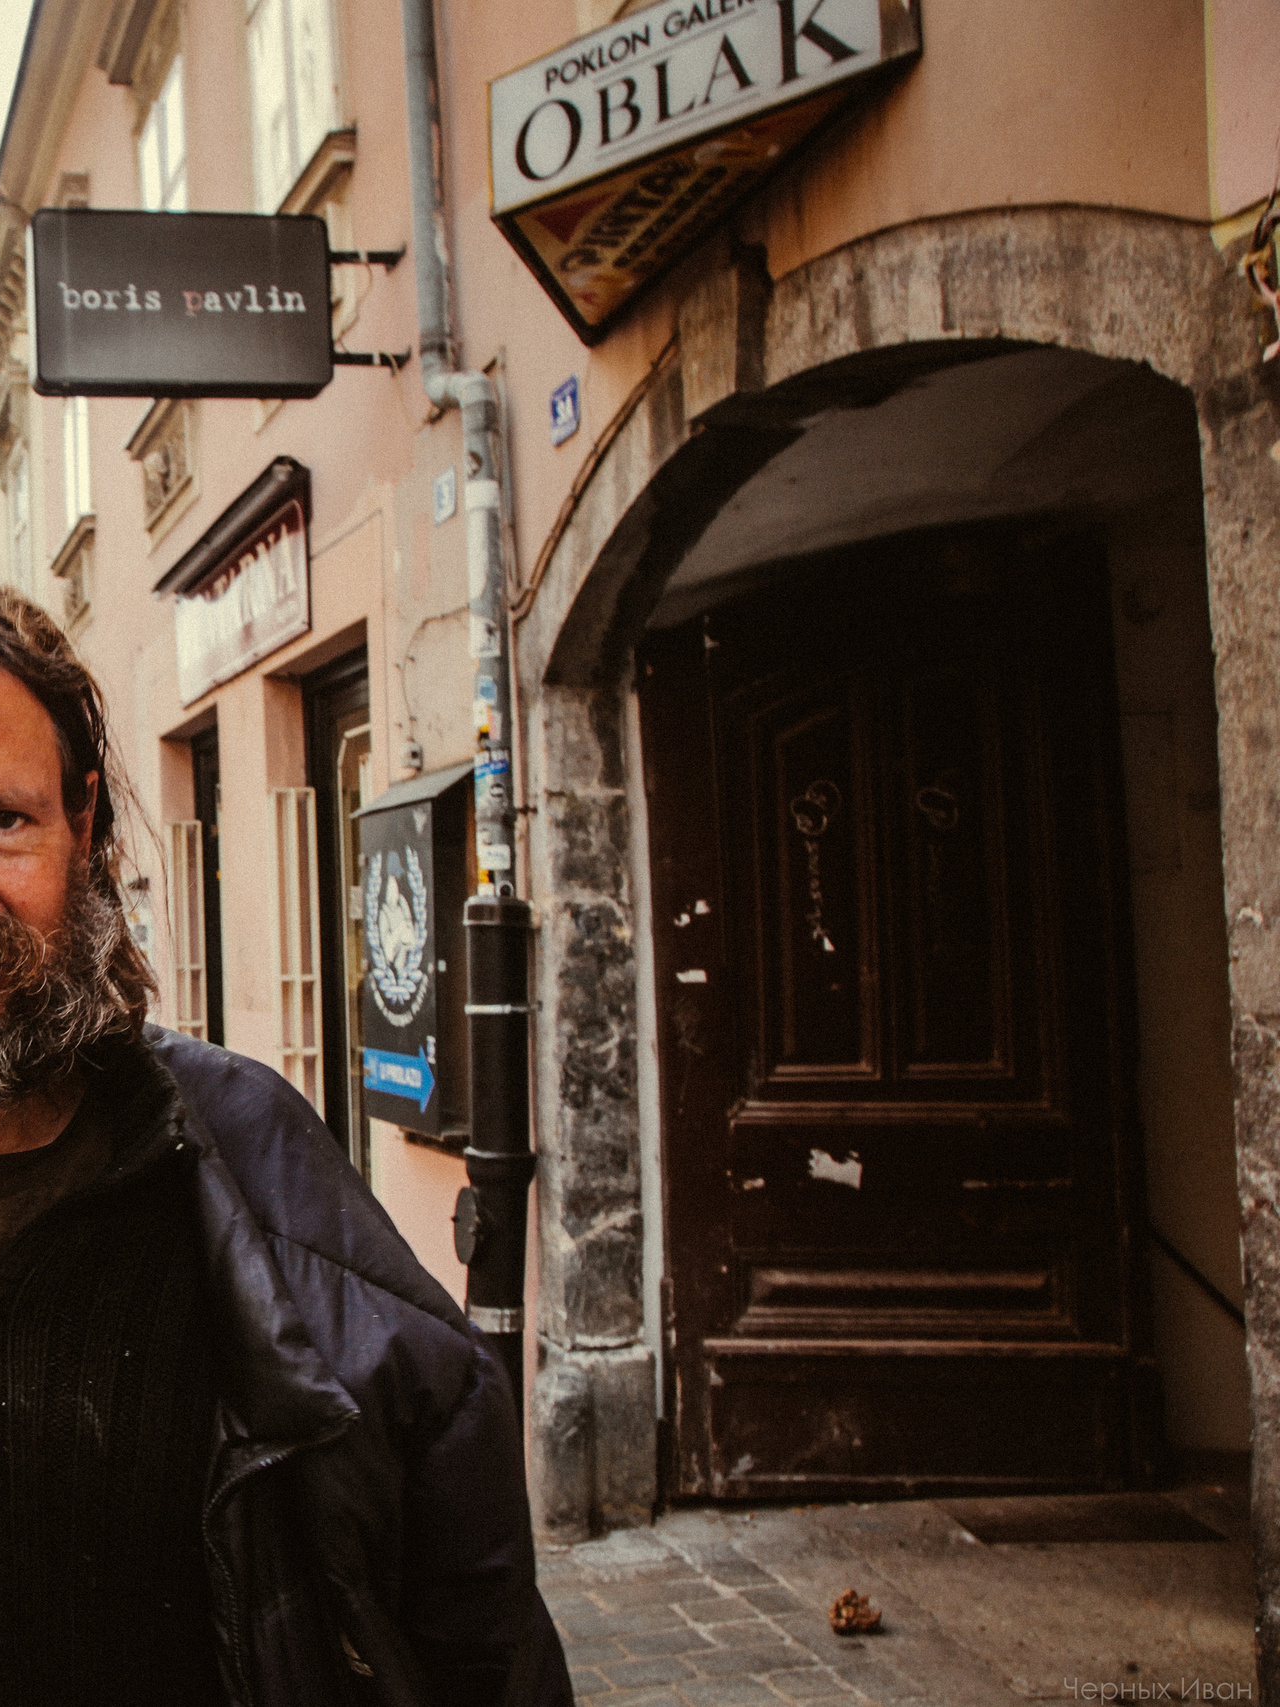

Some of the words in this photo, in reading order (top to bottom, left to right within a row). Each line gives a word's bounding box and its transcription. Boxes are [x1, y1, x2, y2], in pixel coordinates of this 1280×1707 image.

[515, 0, 865, 182] OBLAK
[545, 25, 651, 92] POKLON
[57, 280, 162, 311] boris
[182, 283, 307, 317] pavlin
